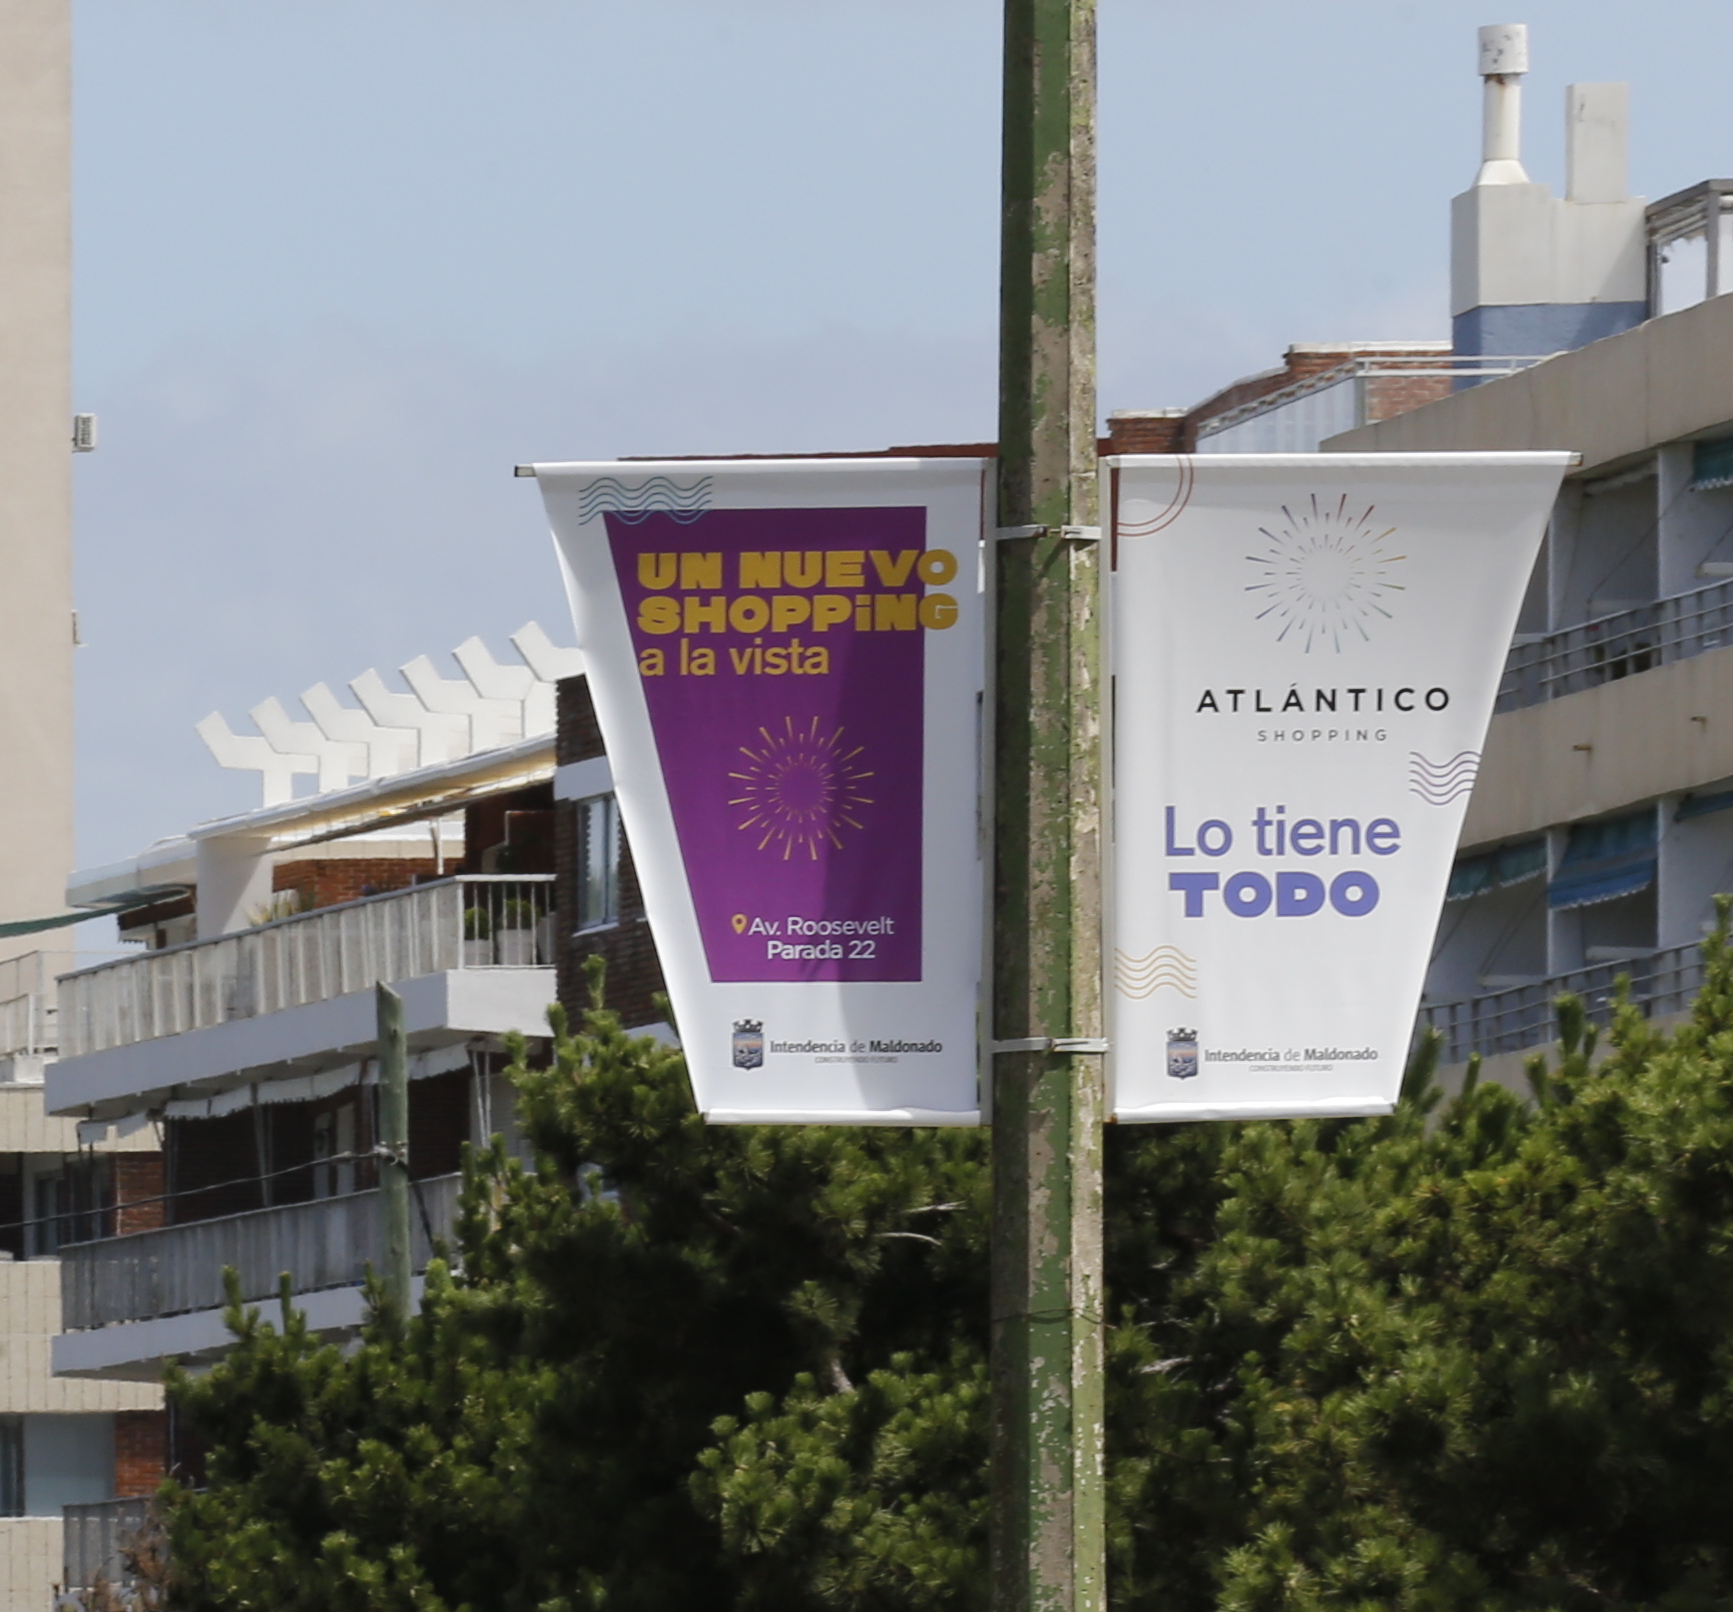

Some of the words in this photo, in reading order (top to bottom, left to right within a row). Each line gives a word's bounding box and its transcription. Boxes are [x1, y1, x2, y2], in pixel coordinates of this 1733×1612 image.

[637, 551, 723, 590] UN
[739, 549, 958, 589] NUEVO
[639, 647, 664, 676] a
[680, 638, 716, 676] la
[729, 637, 830, 676] vista
[1195, 682, 1450, 713] ATLÁNTICO
[1257, 729, 1388, 742] SHOPPING
[1164, 805, 1233, 857] Lo
[1251, 804, 1401, 857] tiene
[1168, 870, 1380, 918] TODO
[748, 917, 782, 935] Av.
[787, 916, 894, 935] Roosevelt
[767, 940, 843, 960] Parada
[848, 940, 876, 959] 22
[770, 1039, 846, 1053] Intendencia
[850, 1040, 866, 1053] de
[869, 1039, 943, 1053] Maldonado
[1205, 1048, 1280, 1062] Intendencia
[1284, 1049, 1301, 1061] de
[1303, 1047, 1379, 1061] Maldonado
